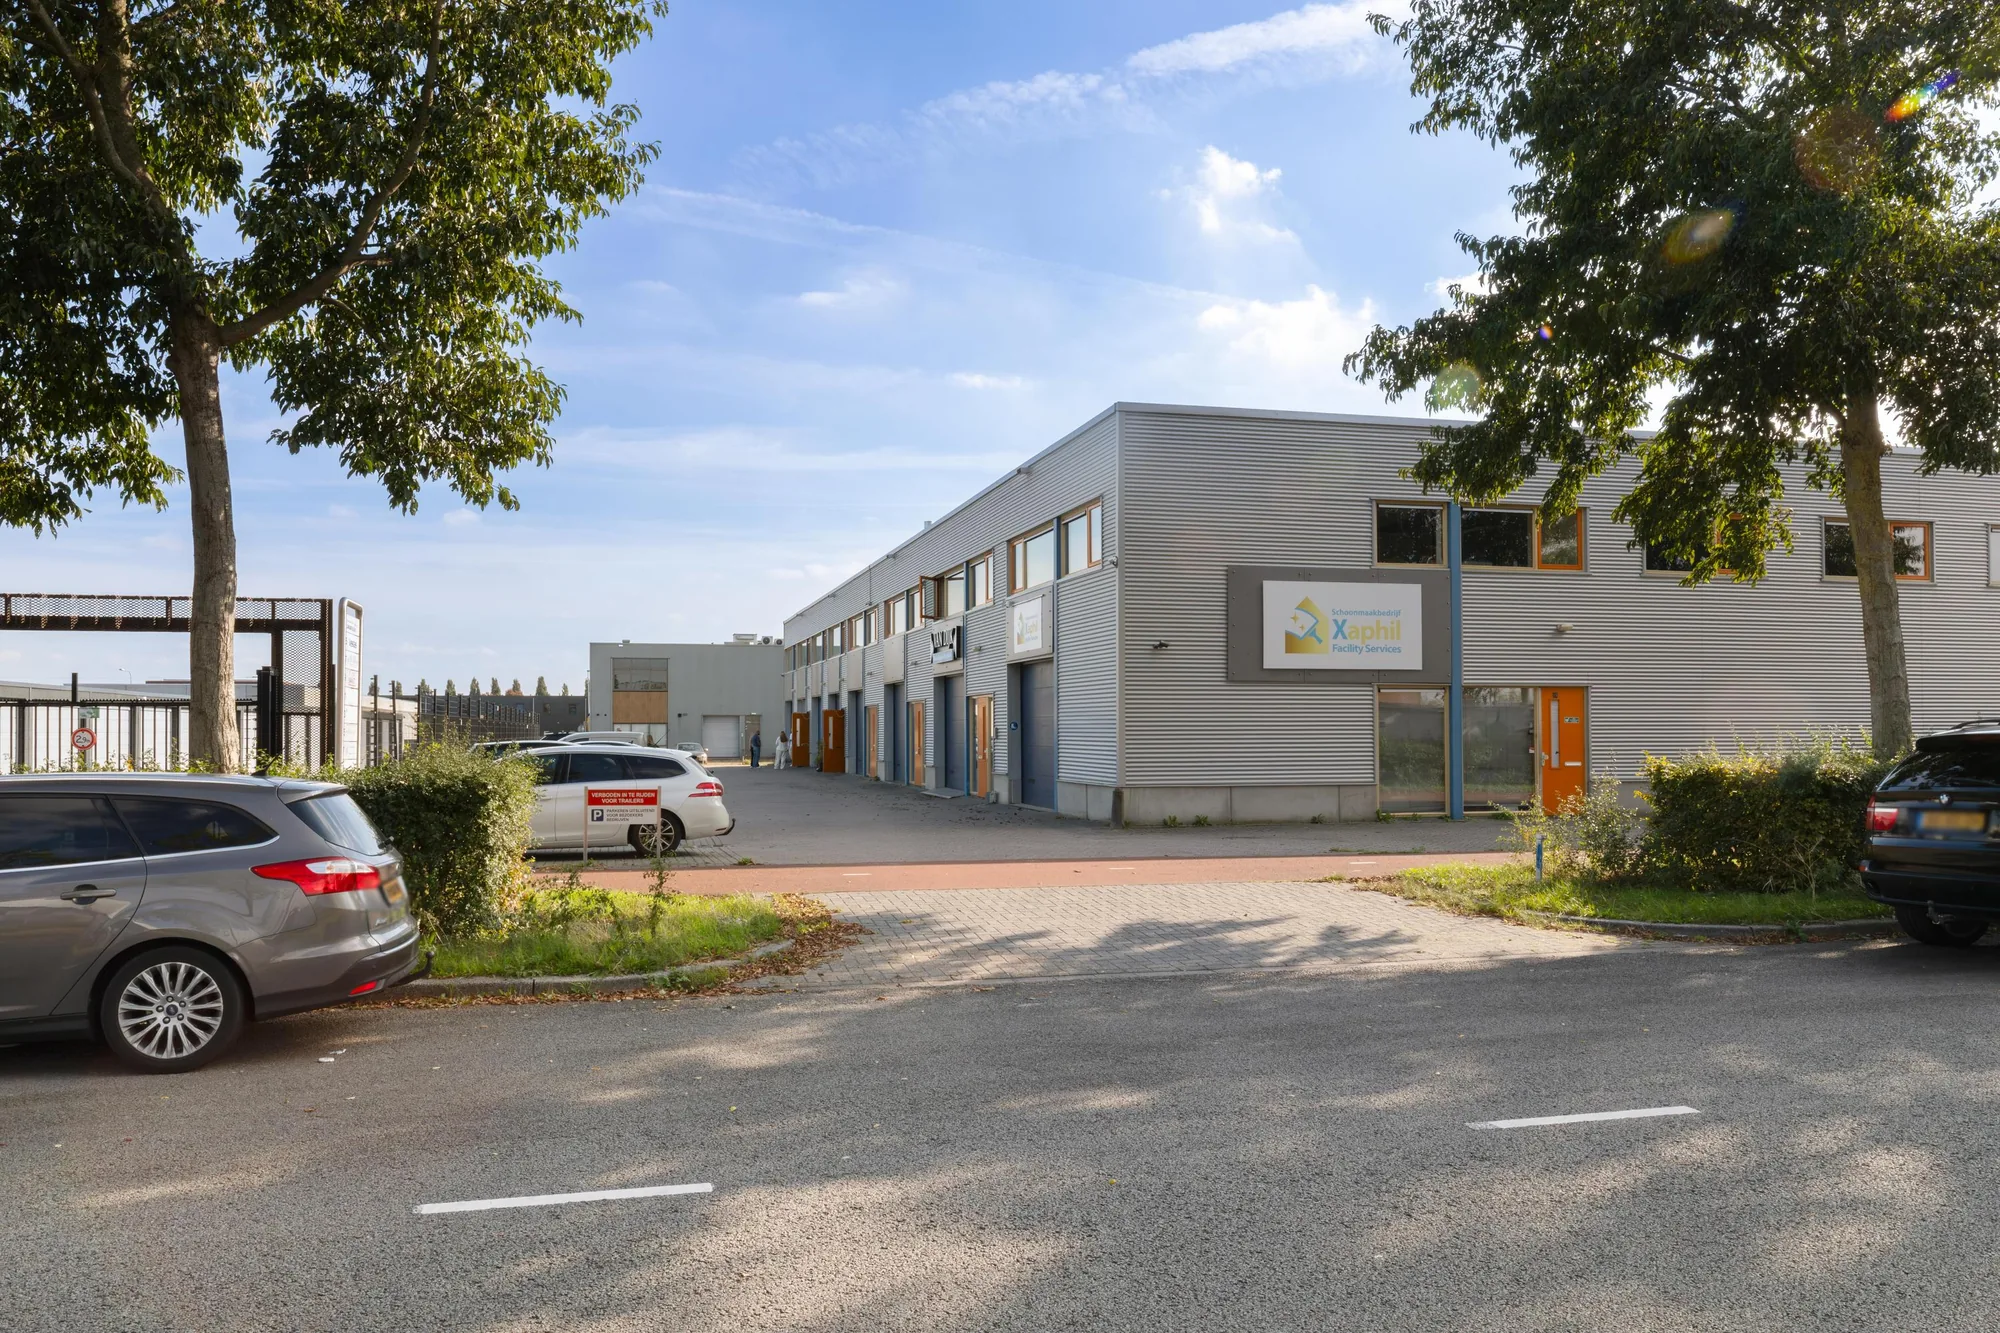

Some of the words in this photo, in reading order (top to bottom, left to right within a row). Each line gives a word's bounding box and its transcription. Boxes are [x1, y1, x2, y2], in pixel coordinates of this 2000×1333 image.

[1331, 608, 1402, 617] Schoonmaakbedrijf
[1332, 618, 1401, 645] Xaphil
[1332, 643, 1364, 655] Facility
[1365, 644, 1402, 653] Services
[593, 810, 603, 821] P
